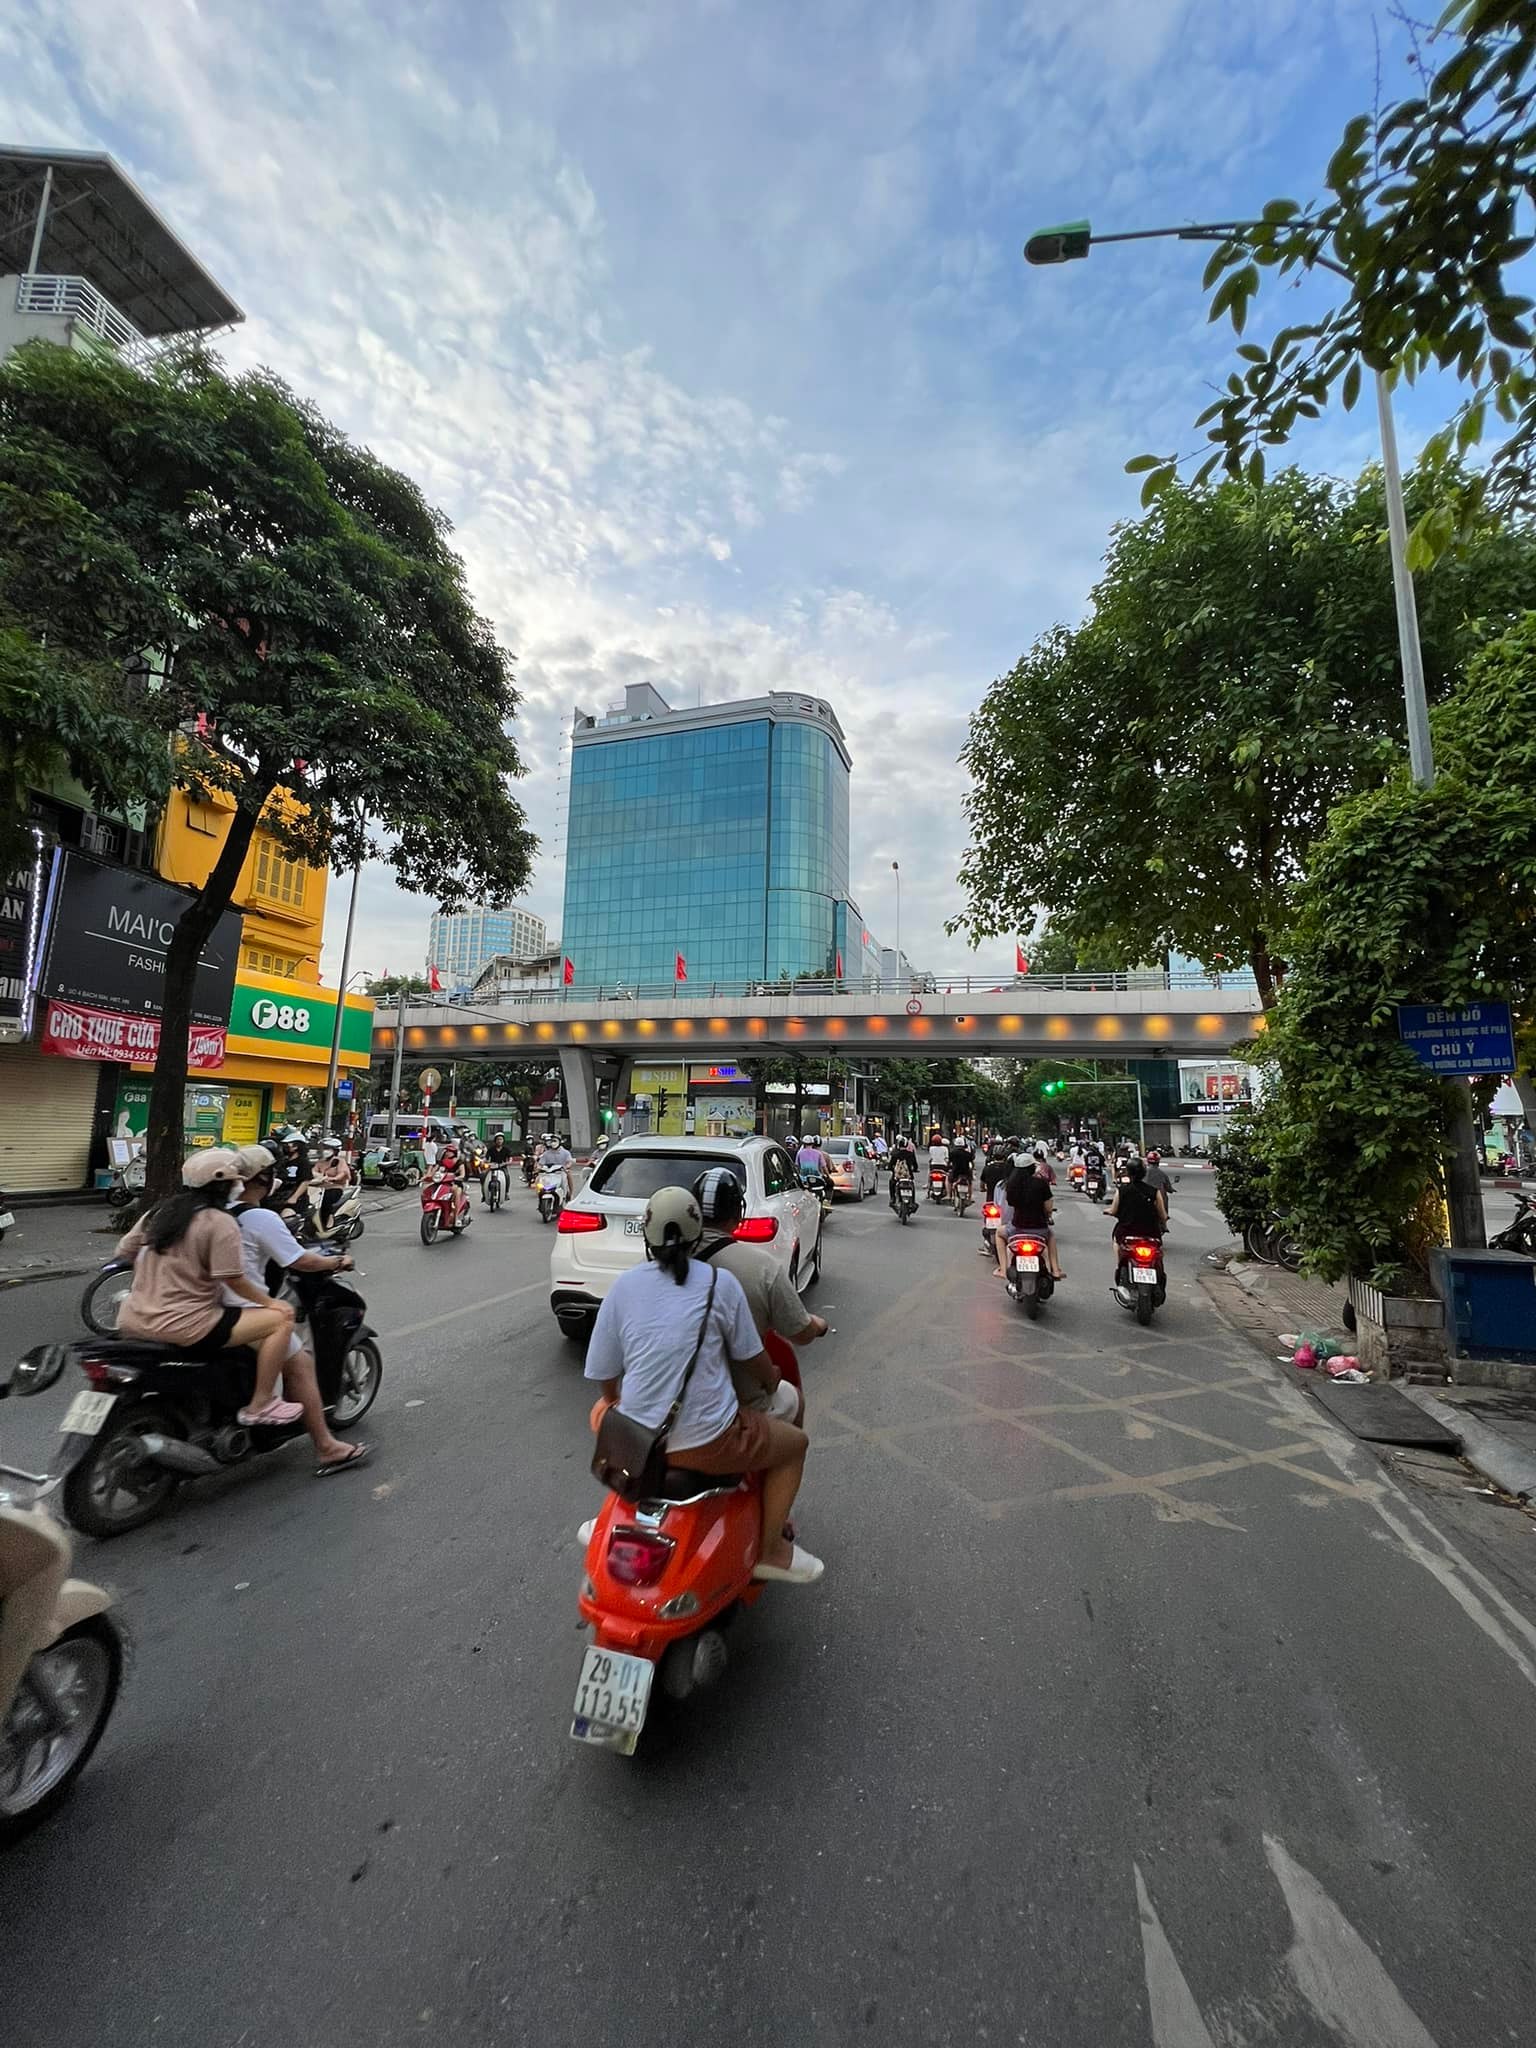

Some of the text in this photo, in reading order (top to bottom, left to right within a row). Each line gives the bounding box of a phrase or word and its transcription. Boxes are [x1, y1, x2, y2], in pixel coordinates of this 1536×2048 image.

[127, 953, 167, 975] FASHI
[49, 1010, 84, 1040] CHO
[87, 1016, 126, 1046] THUÊ
[1431, 1039, 1475, 1056] CHÚ Ý
[579, 1684, 642, 1725] 113.55
